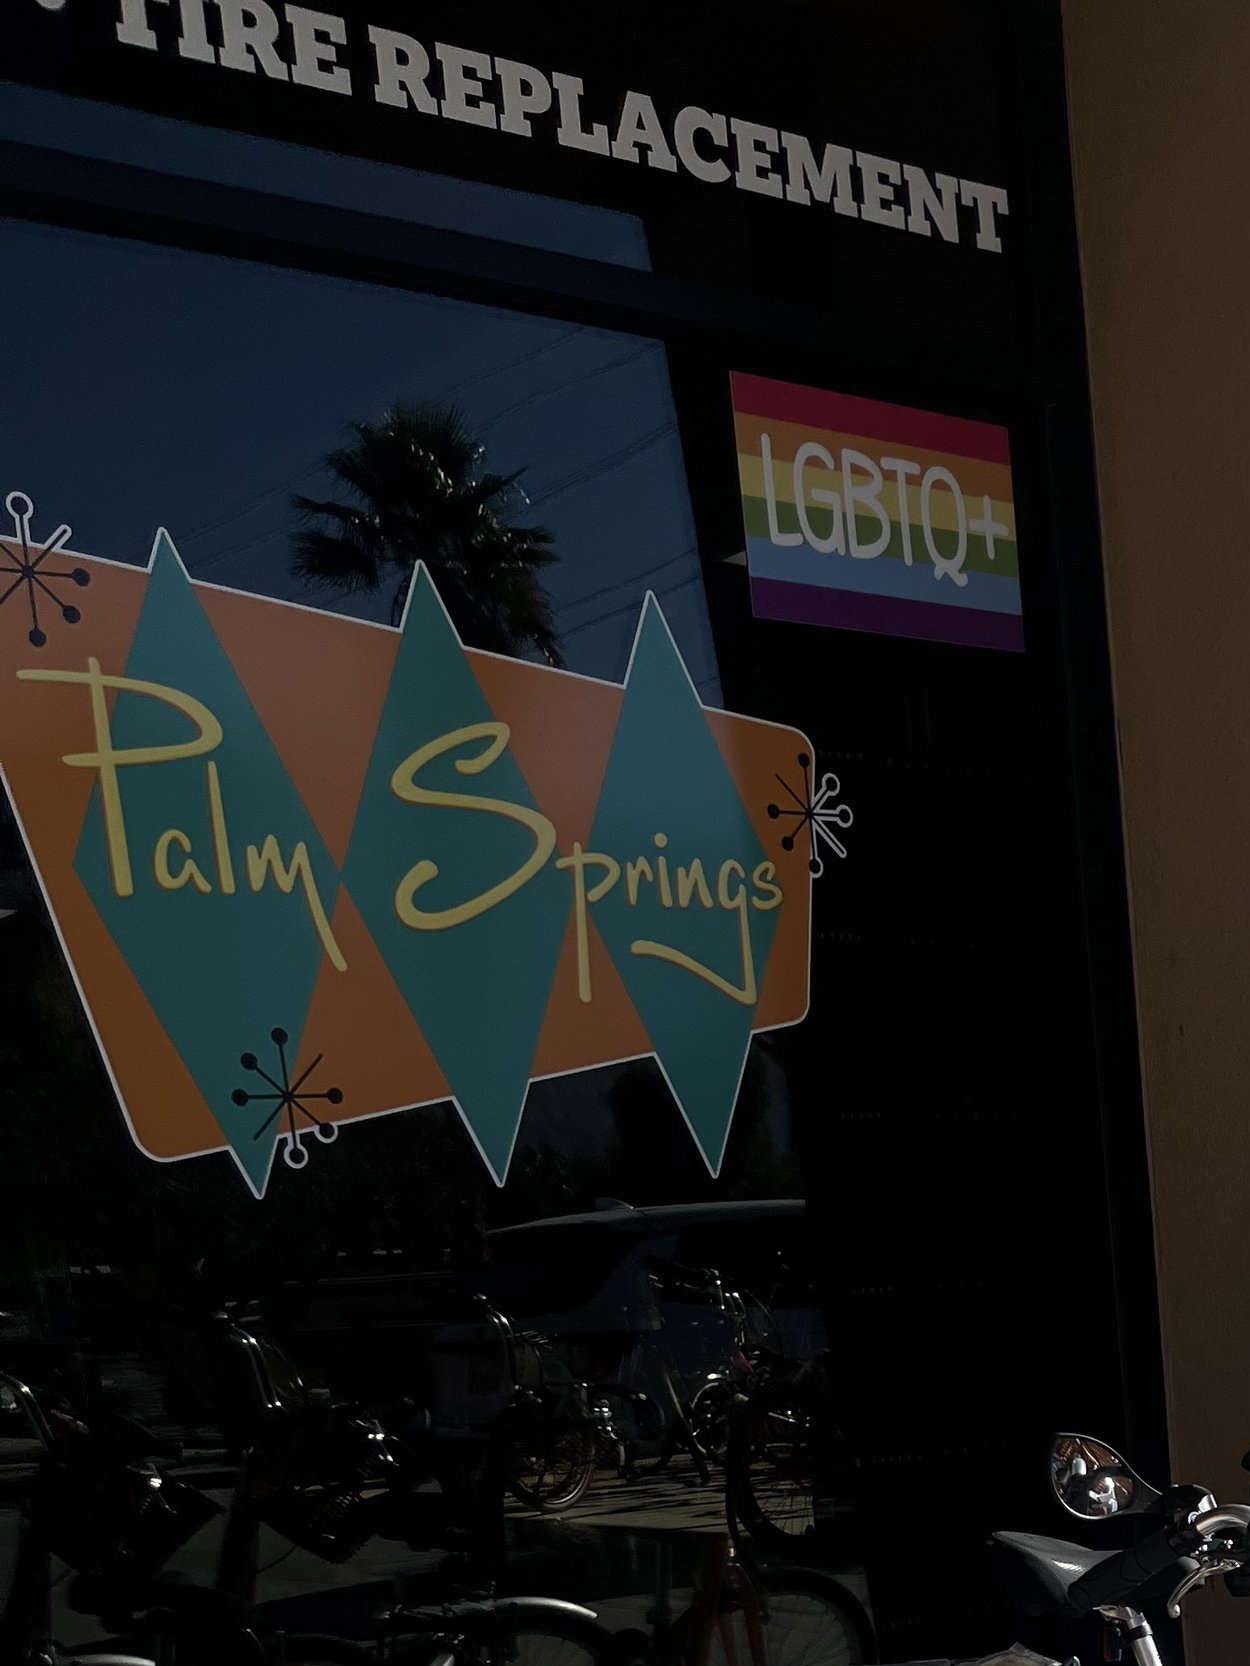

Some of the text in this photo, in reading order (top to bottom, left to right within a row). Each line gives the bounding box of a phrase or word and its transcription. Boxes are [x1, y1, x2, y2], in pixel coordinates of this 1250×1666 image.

[114, 0, 1008, 254] TIRE REPLACEMENT
[759, 432, 1008, 588] LGBTQ+
[15, 656, 783, 1005] Palm Springs
